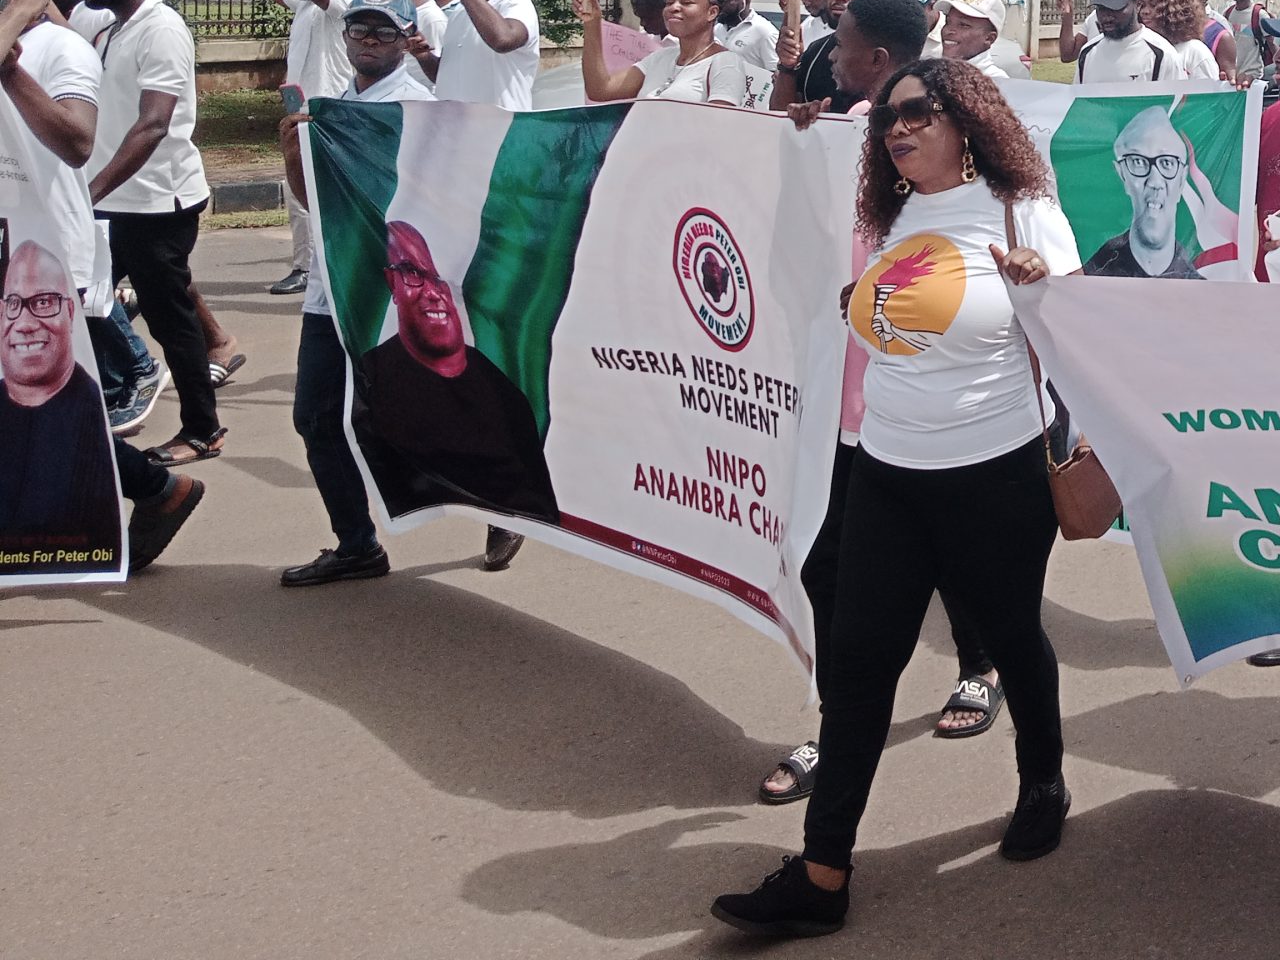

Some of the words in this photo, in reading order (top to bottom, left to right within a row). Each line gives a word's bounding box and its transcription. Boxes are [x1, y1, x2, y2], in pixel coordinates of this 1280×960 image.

[690, 222, 715, 240] NEEDS
[715, 229, 737, 264] PETER
[681, 232, 695, 280] NIGERIA
[734, 266, 746, 290] OBI
[699, 304, 747, 341] MOVEMENT
[591, 347, 687, 379] NIGERIA
[691, 355, 749, 395] NEEDS
[679, 383, 780, 439] MOVEMENT
[706, 446, 766, 498] NNPO
[634, 463, 743, 528] ANAMBRA
[33, 550, 54, 563] For
[56, 549, 89, 562] Peter
[92, 548, 113, 561] Obi
